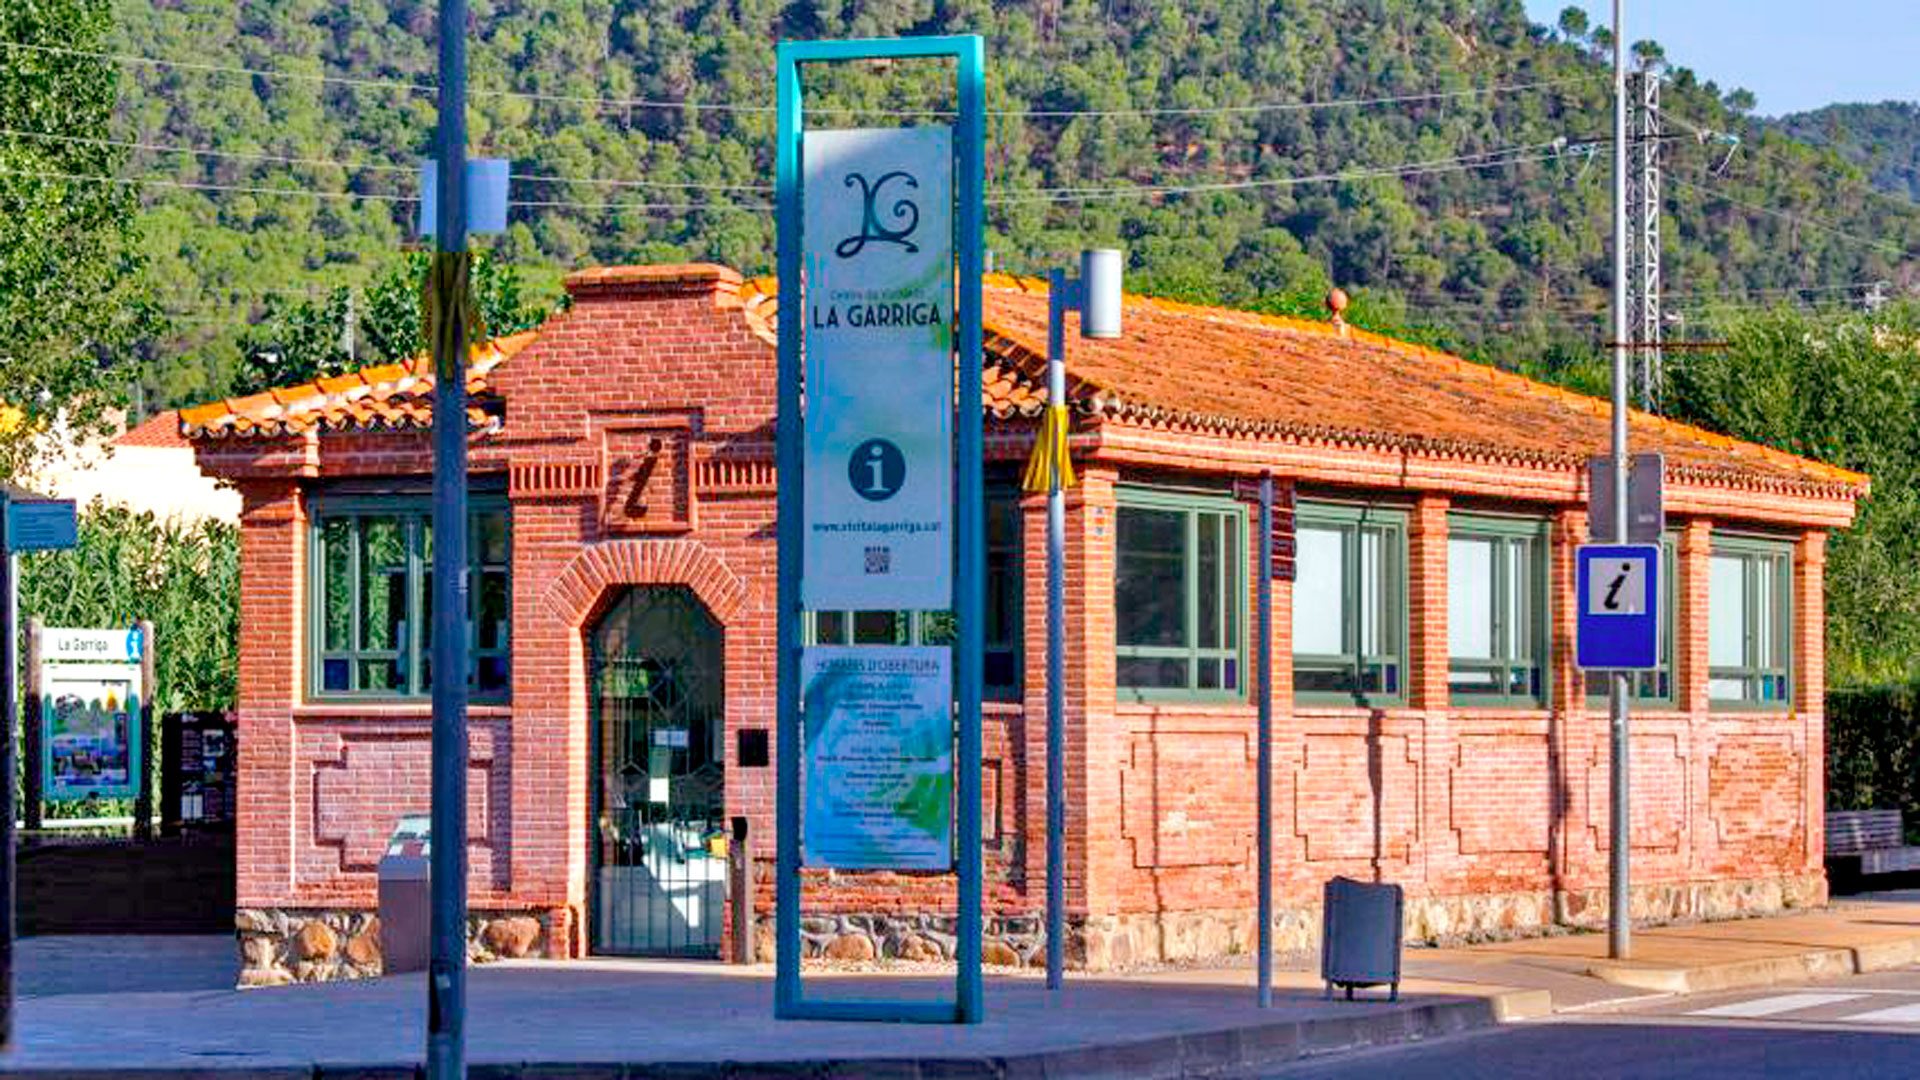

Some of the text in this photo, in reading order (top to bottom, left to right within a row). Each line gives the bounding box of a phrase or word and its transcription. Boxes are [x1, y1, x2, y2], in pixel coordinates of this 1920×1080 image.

[813, 303, 942, 329] LA GARRIGA
[58, 637, 109, 654] La Garriga
